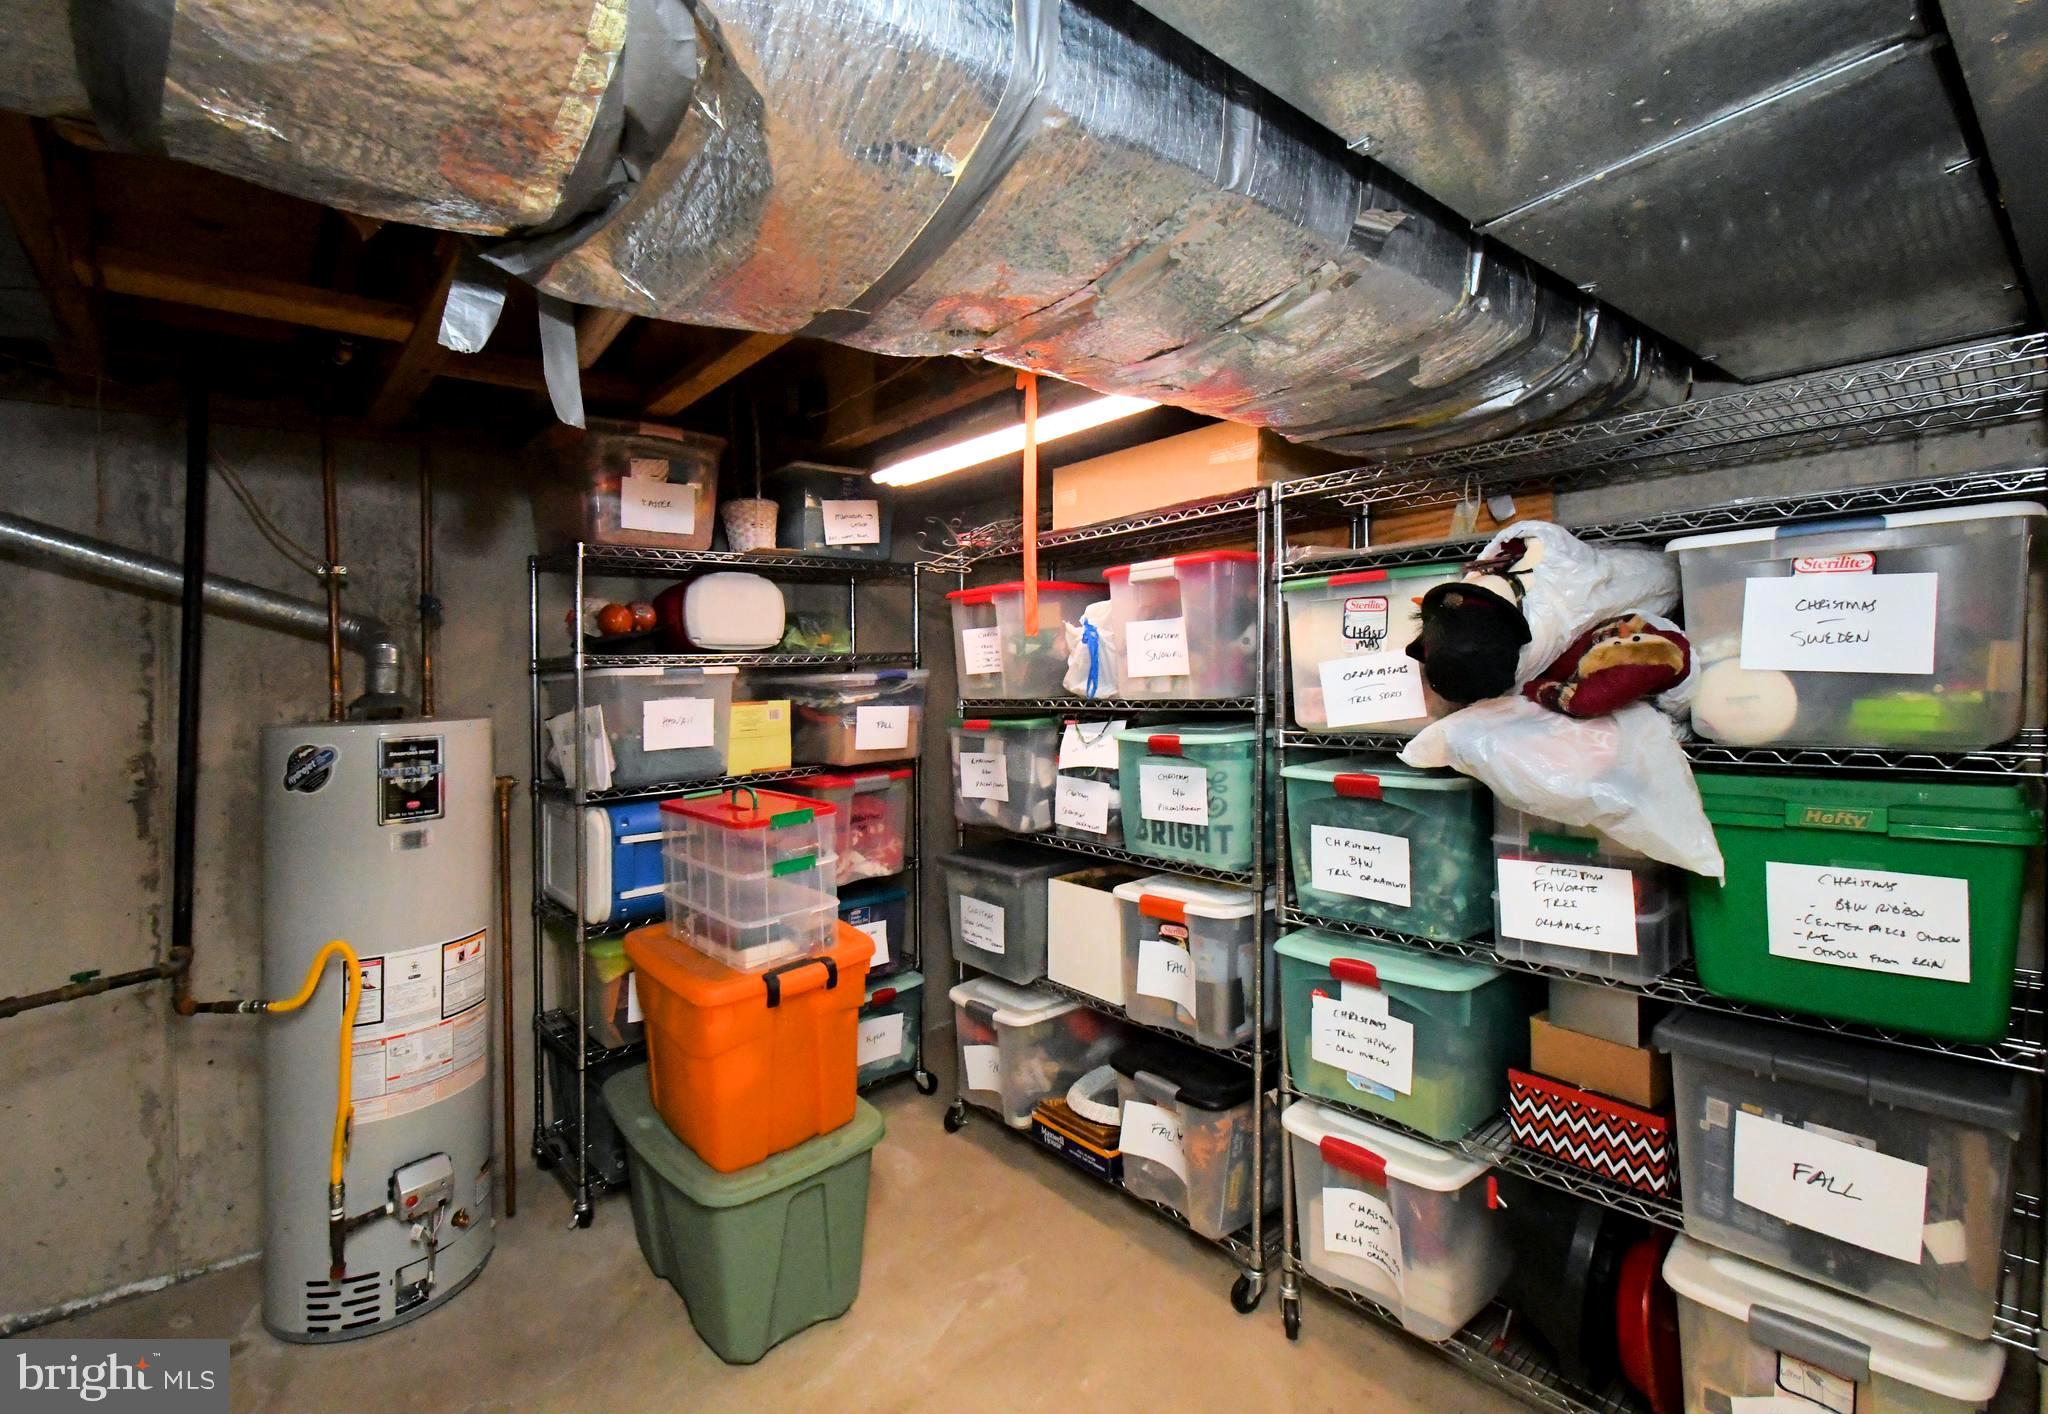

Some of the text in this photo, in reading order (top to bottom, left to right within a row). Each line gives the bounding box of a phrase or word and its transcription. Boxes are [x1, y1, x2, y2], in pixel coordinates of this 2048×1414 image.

[1801, 555, 1869, 570] Sterilite
[1350, 600, 1384, 610] Sterilite
[1795, 598, 1878, 612] CHRISTMAS
[1790, 629, 1871, 647] SWEDEN
[1805, 809, 1868, 828] Hefty
[1792, 1162, 1863, 1201] FALL
